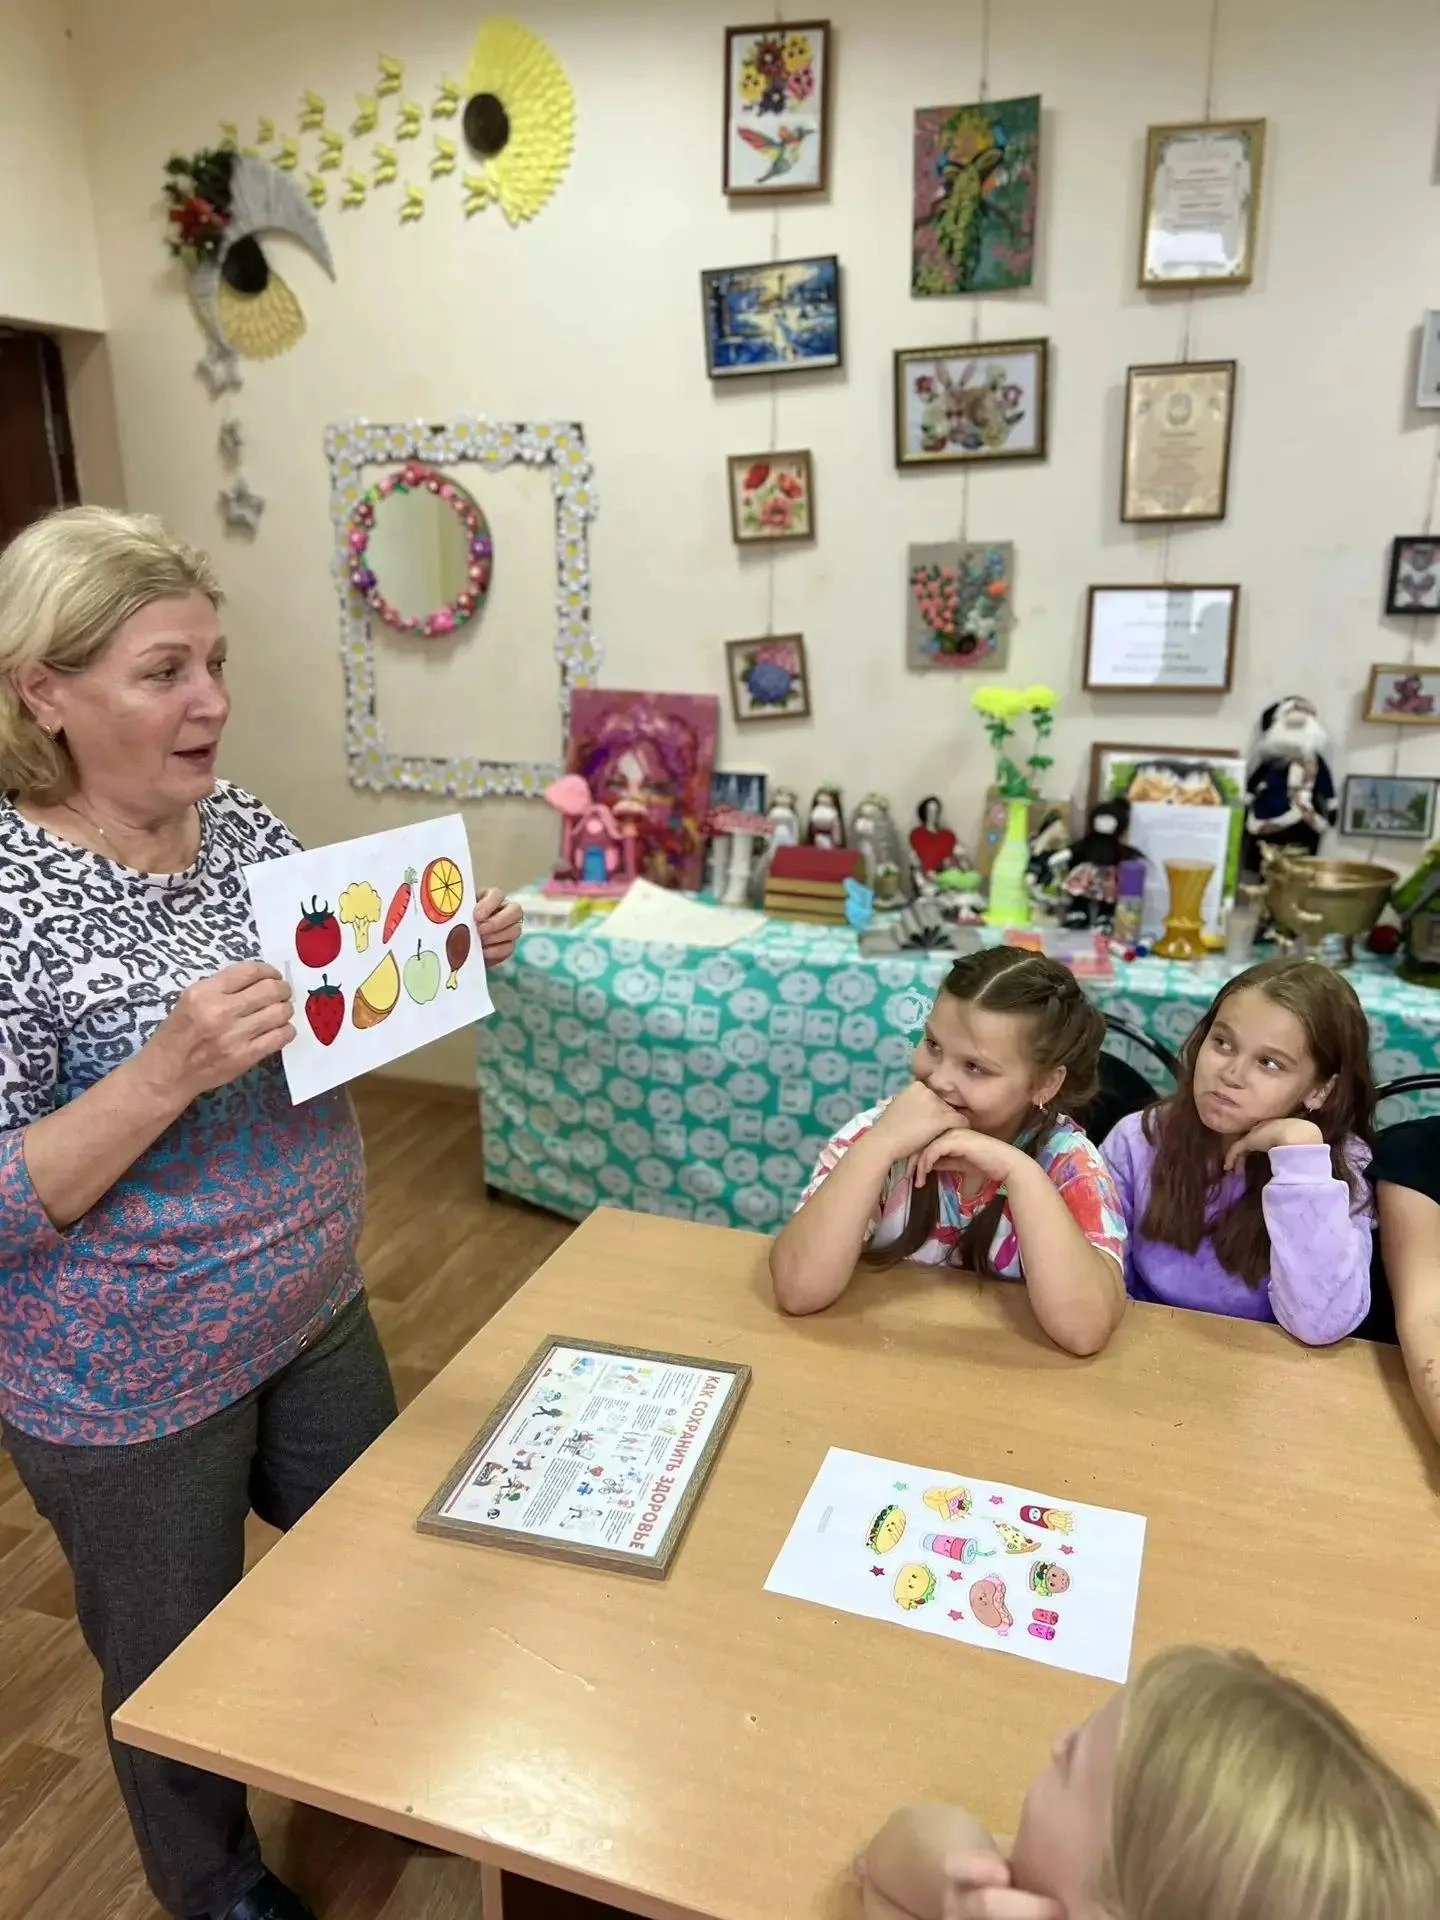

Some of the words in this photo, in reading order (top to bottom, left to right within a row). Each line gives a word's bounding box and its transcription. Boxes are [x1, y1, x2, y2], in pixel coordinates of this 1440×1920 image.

[699, 1375, 720, 1399] КАК
[665, 1401, 708, 1472] СОХРАНИТЬ
[630, 1475, 675, 1549] ЗДОРОВЬЕ
